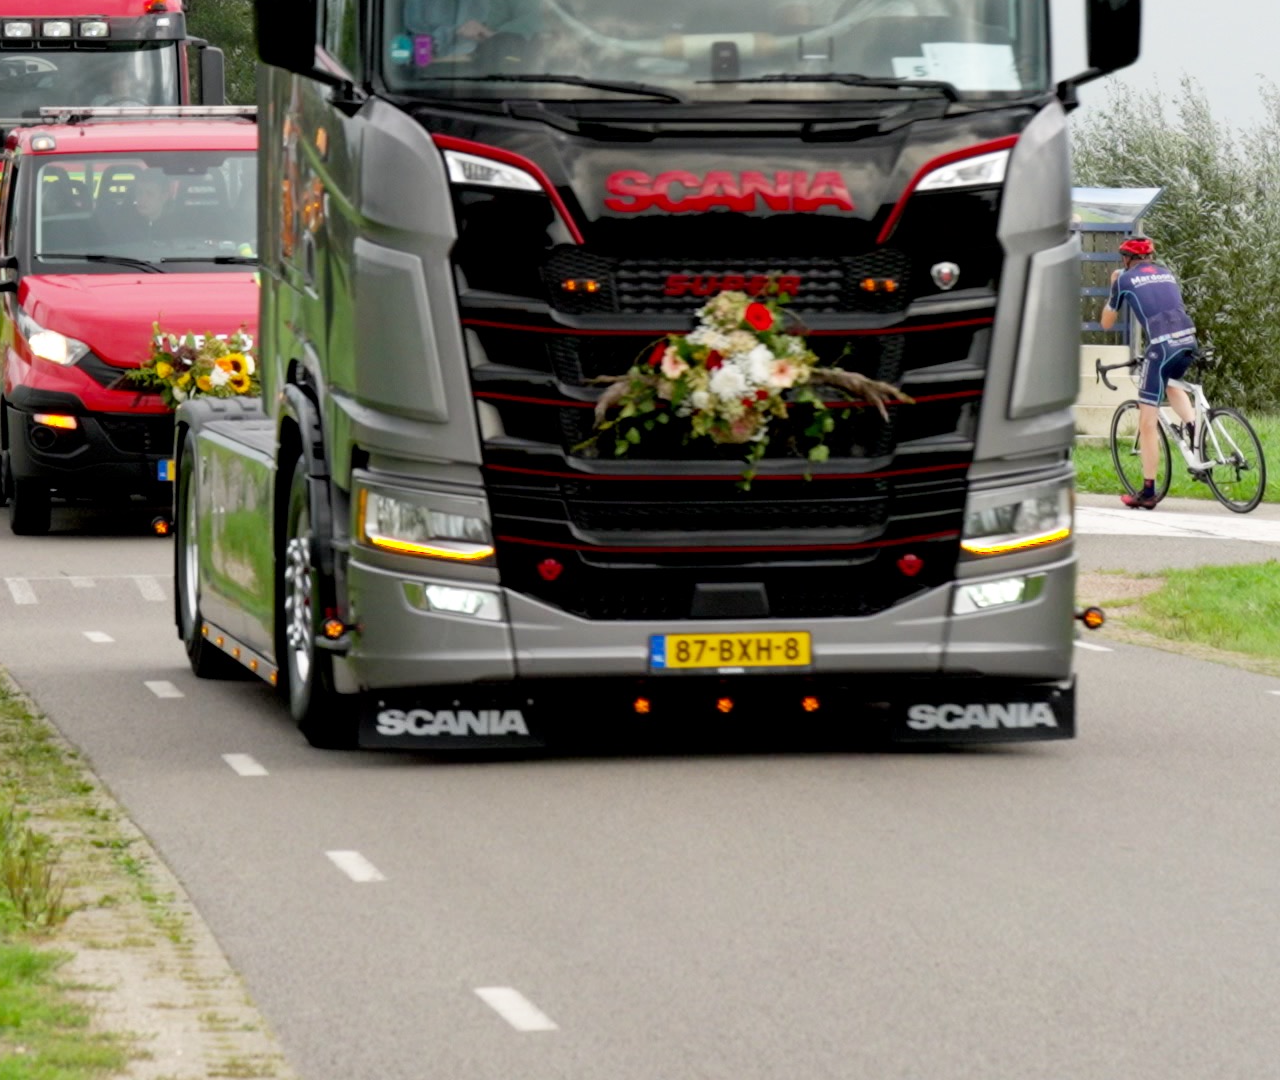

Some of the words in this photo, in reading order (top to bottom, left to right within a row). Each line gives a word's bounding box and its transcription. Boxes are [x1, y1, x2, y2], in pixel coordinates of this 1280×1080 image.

[604, 170, 856, 213] SCANIA
[664, 274, 801, 296] SUPER
[675, 637, 800, 663] 87-BXH-8
[376, 708, 530, 736] SCANIA
[906, 702, 1058, 731] SCANIA
